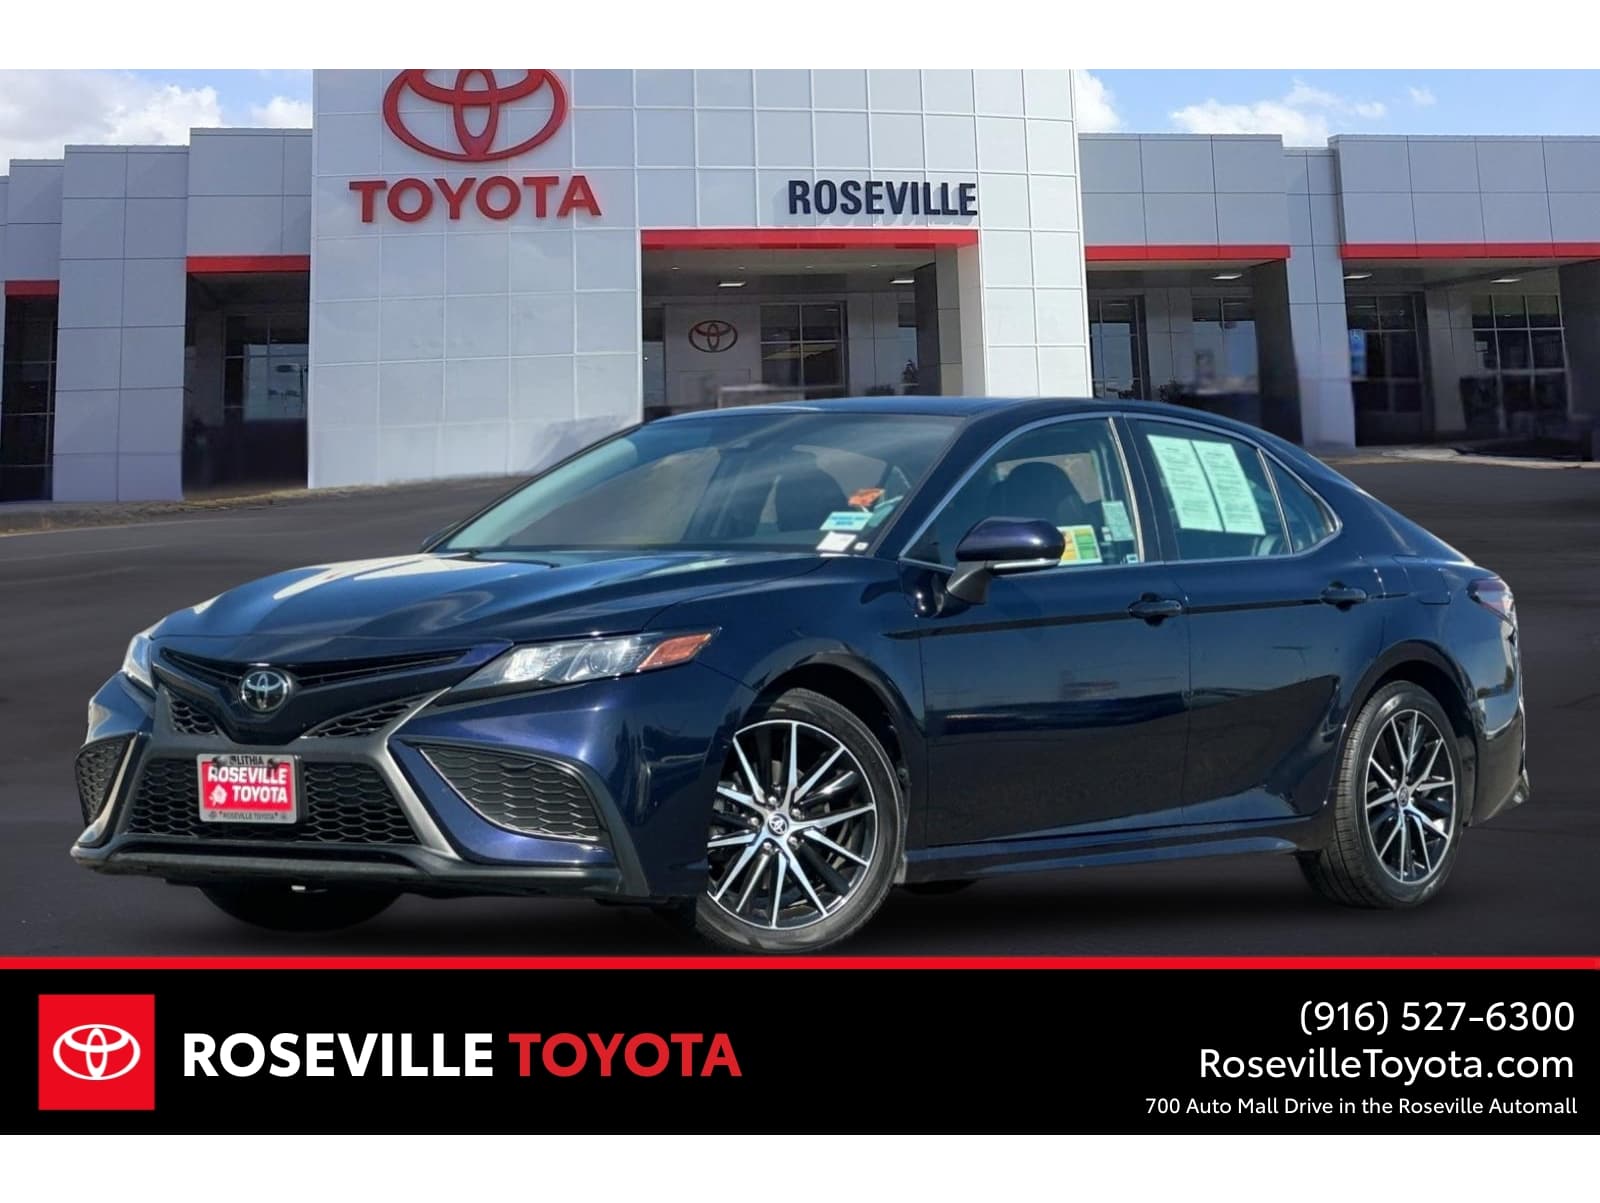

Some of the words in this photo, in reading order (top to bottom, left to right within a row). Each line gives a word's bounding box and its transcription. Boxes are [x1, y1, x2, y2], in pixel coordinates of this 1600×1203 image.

[349, 175, 602, 223] TOYOTA
[788, 180, 978, 217] ROSEVILLE
[207, 766, 287, 784] ROSEVILLE
[232, 785, 288, 803] TOYOTA
